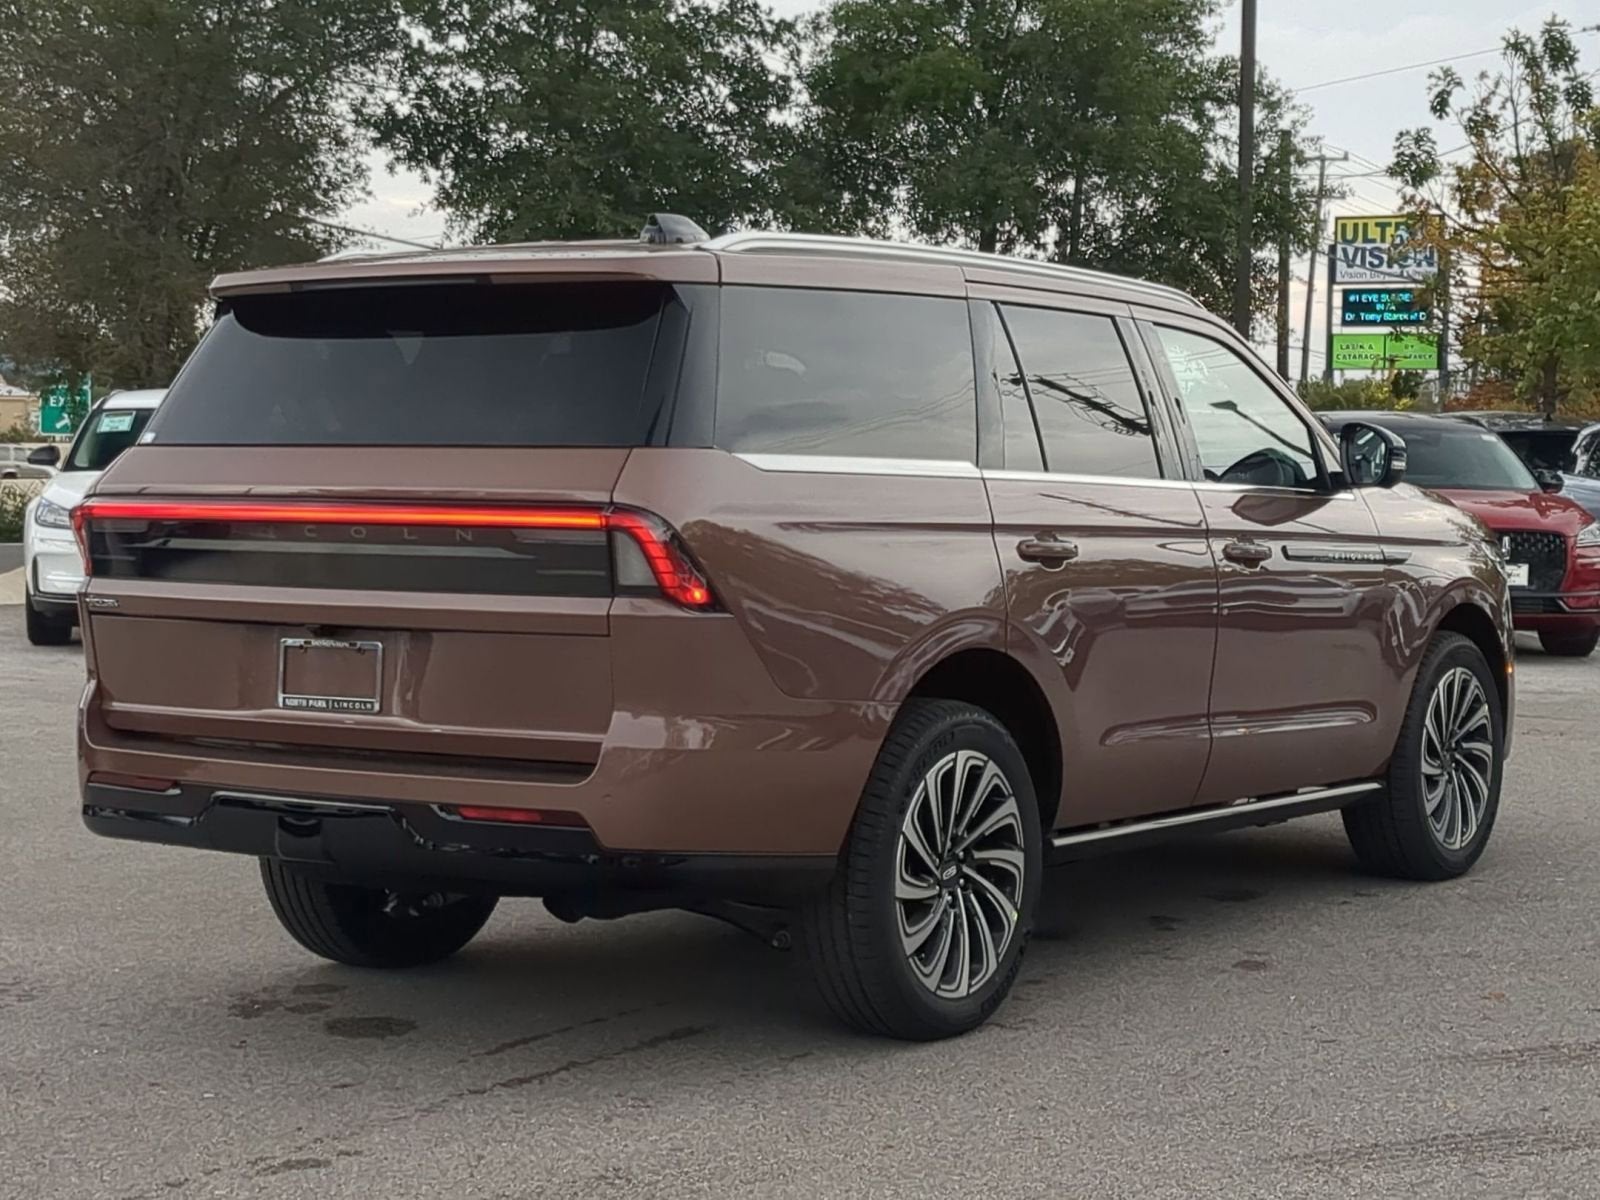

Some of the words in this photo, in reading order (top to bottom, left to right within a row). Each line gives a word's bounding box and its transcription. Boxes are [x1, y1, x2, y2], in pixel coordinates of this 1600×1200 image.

[1341, 221, 1407, 243] ULT
[1361, 293, 1379, 302] EYE
[50, 396, 80, 407] EXT
